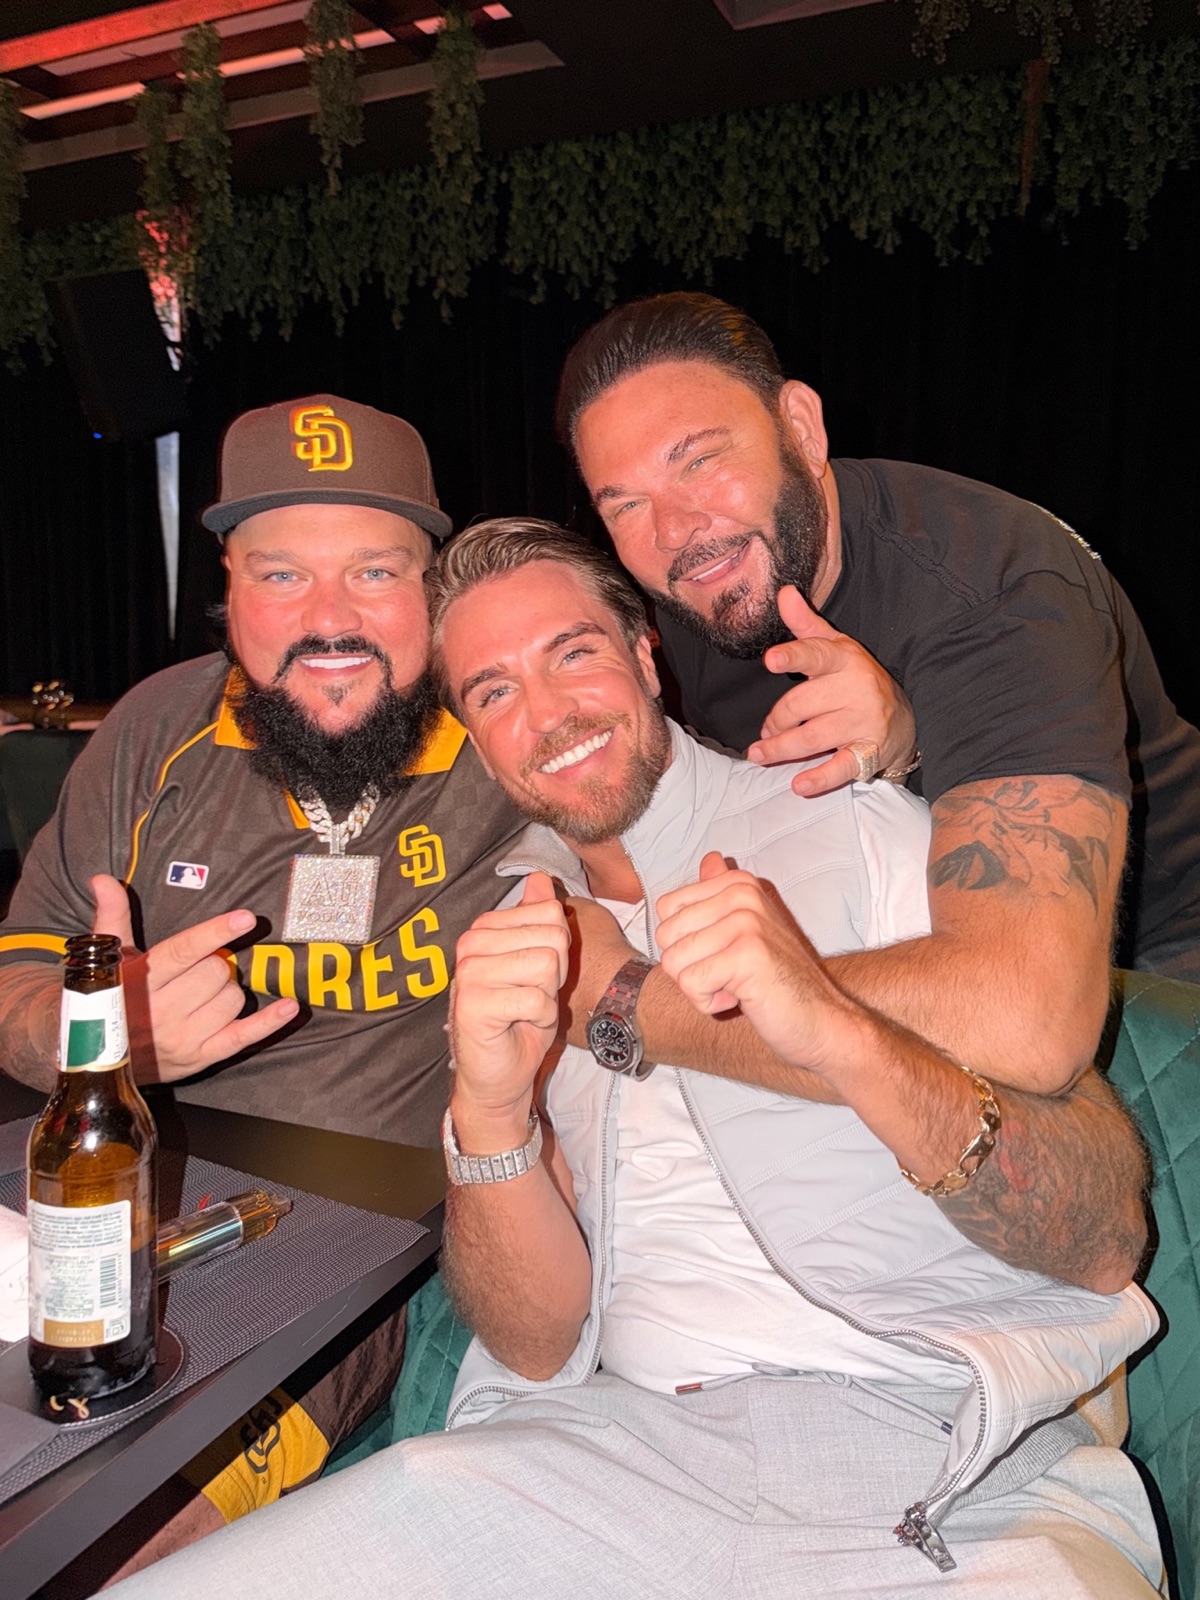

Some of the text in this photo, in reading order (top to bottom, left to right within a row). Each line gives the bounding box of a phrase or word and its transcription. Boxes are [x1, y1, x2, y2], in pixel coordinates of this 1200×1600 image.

[290, 405, 353, 472] SD
[399, 824, 446, 888] SD
[227, 906, 449, 1012] DRES
